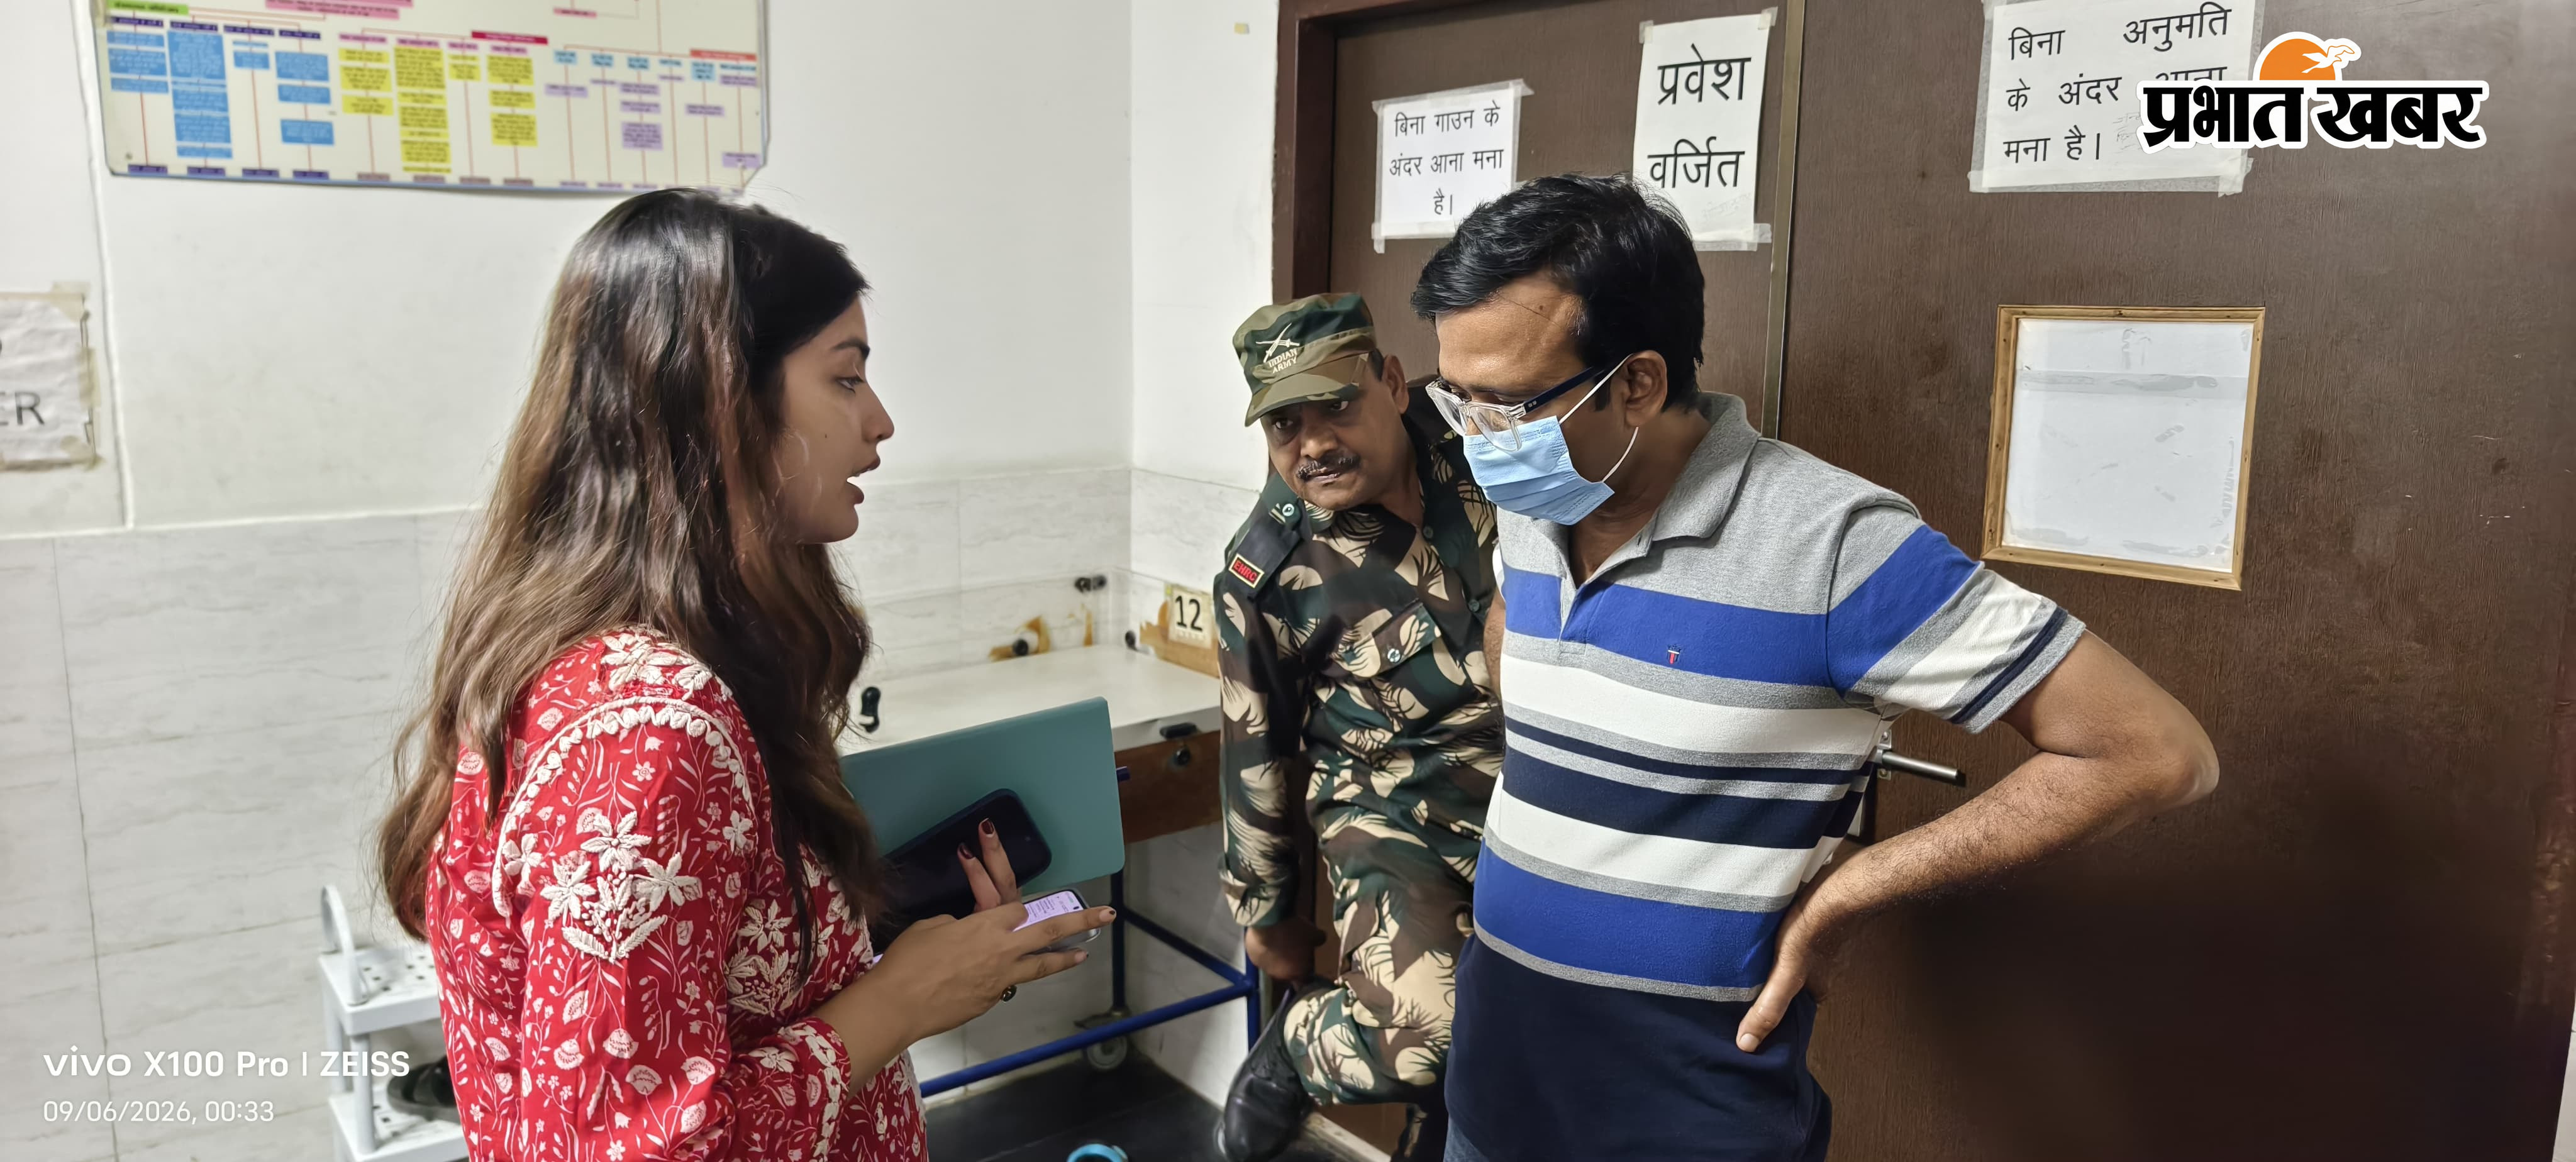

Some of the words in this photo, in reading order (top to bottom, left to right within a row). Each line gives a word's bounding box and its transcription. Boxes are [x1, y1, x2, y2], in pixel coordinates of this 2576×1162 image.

[2008, 26, 2066, 60] बिना
[2123, 1, 2233, 52] अनुमति
[1657, 43, 1752, 105] प्रवेश
[2006, 78, 2031, 111] के
[2057, 73, 2123, 106] अंदर
[1394, 111, 1426, 137] बिना
[1434, 109, 1475, 133] गाउन
[1483, 100, 1501, 127] के
[1389, 153, 1423, 176] अंदर
[1430, 152, 1465, 174] आना
[1472, 149, 1504, 169] मना
[1647, 136, 1745, 188] वर्जित
[2002, 138, 2051, 163] मना
[1269, 348, 1297, 368] INDIAN
[1272, 357, 1297, 374] ARMY
[1175, 595, 1202, 632] 12
